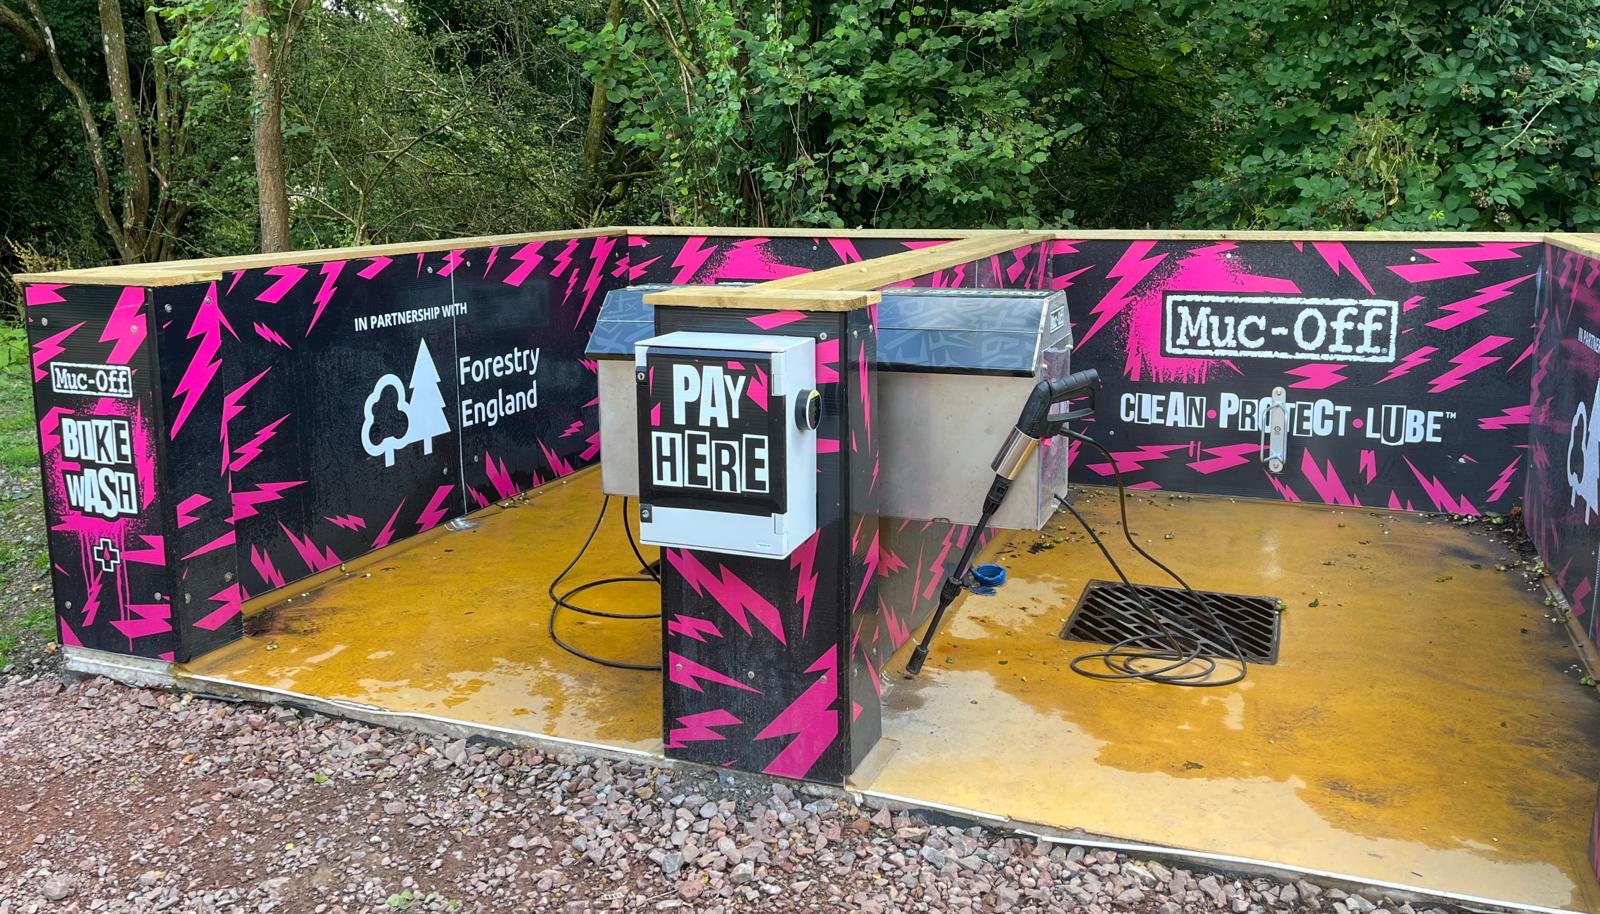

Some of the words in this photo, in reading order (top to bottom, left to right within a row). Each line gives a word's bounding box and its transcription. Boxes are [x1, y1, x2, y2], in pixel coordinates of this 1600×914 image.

[354, 317, 368, 332] IN
[370, 306, 440, 330] PARTNERSHIP
[441, 302, 468, 318] WITH
[1175, 305, 1387, 354] Muc-Off
[54, 367, 130, 393] Muc-Off
[459, 347, 540, 385] Forestry
[461, 380, 538, 428] England
[672, 363, 746, 428] PAY
[1120, 391, 1207, 428] CLEAN
[61, 417, 132, 465] BIKE
[651, 429, 770, 494] HERE
[65, 467, 138, 518] WASH
